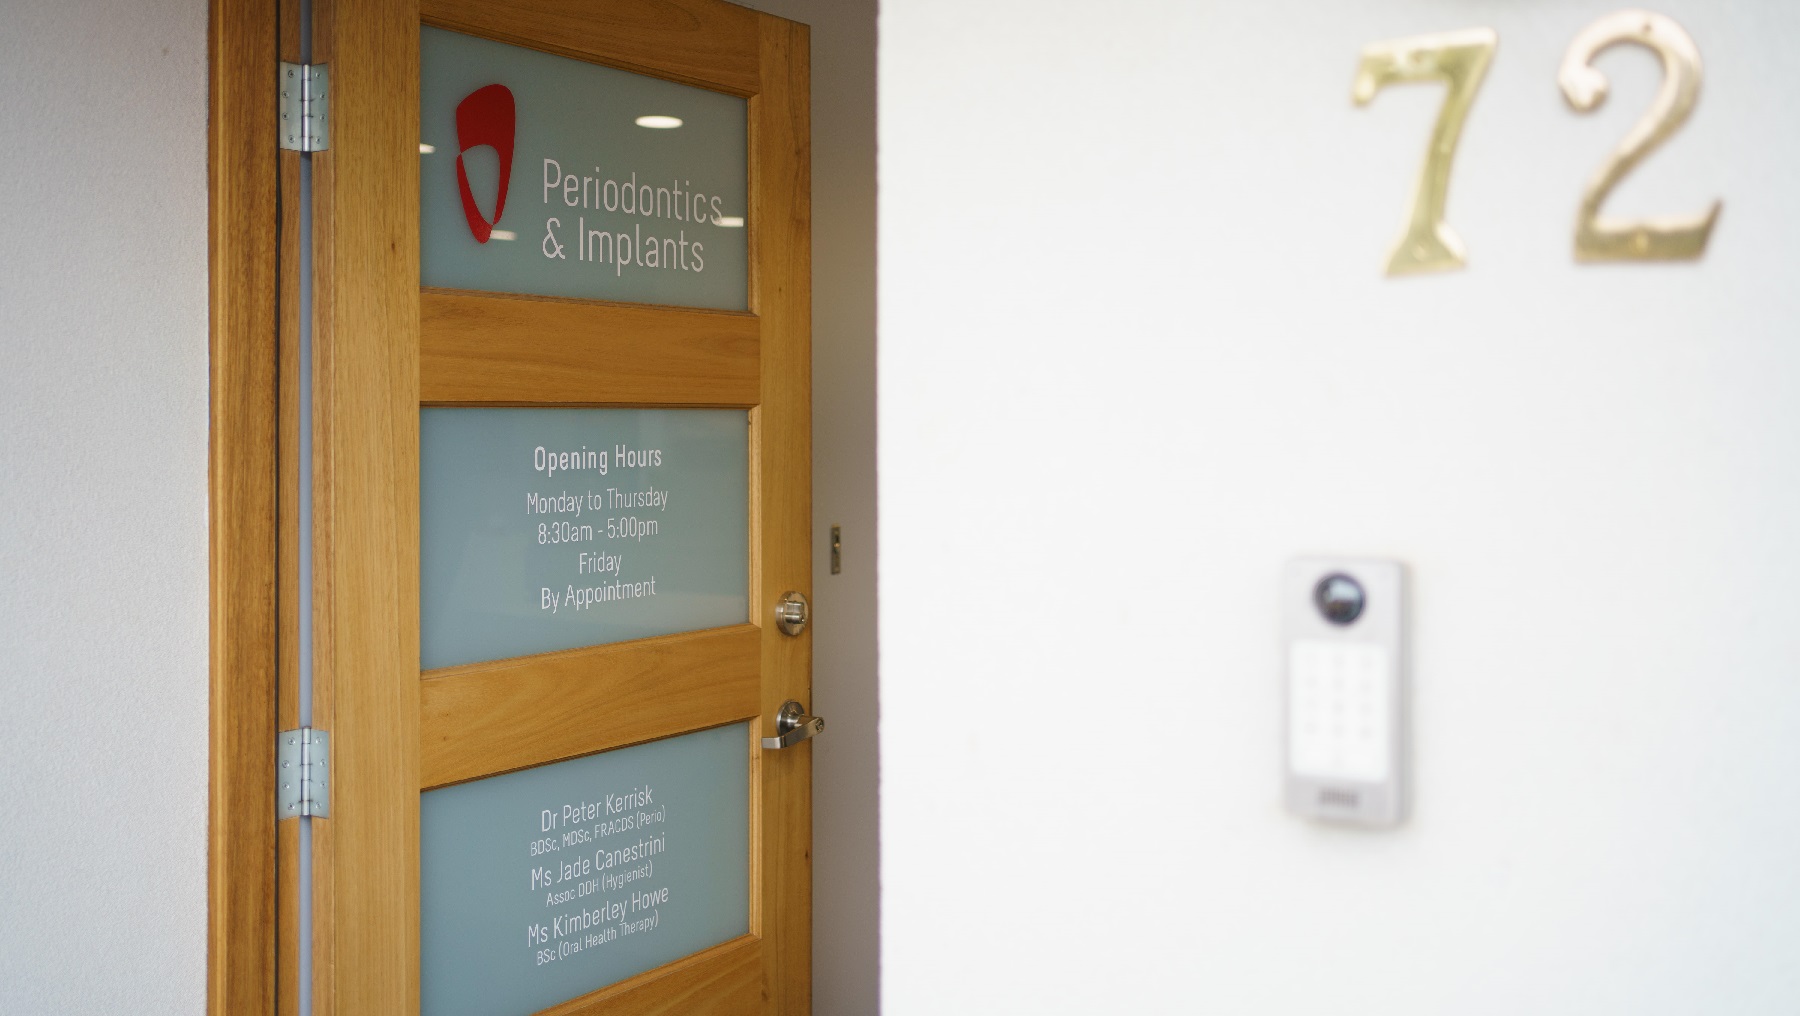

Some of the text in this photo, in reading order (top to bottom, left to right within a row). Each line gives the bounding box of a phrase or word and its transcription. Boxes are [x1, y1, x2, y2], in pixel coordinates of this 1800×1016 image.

[1352, 7, 1722, 278] 72
[543, 158, 723, 225] Periodontics
[542, 216, 704, 277] & Implants
[534, 444, 662, 477] Opening Hours
[527, 486, 668, 517] Monday to Thursday
[538, 521, 593, 544] 8:30am
[607, 516, 658, 542] 5:00pm
[579, 551, 622, 577] Friday
[541, 576, 656, 614] By Appointment
[530, 804, 666, 857] BDSc, MDSc, FRACDS (Perio)
[541, 785, 653, 832] Dr Peter Kerrisk
[531, 832, 665, 891] Ms Jade Canestrini
[546, 860, 653, 907] Assoc DDH (Hygienist)
[528, 887, 669, 947] Ms Kimberley Howe
[537, 908, 659, 966] BSc (Oral Health Therapy)
